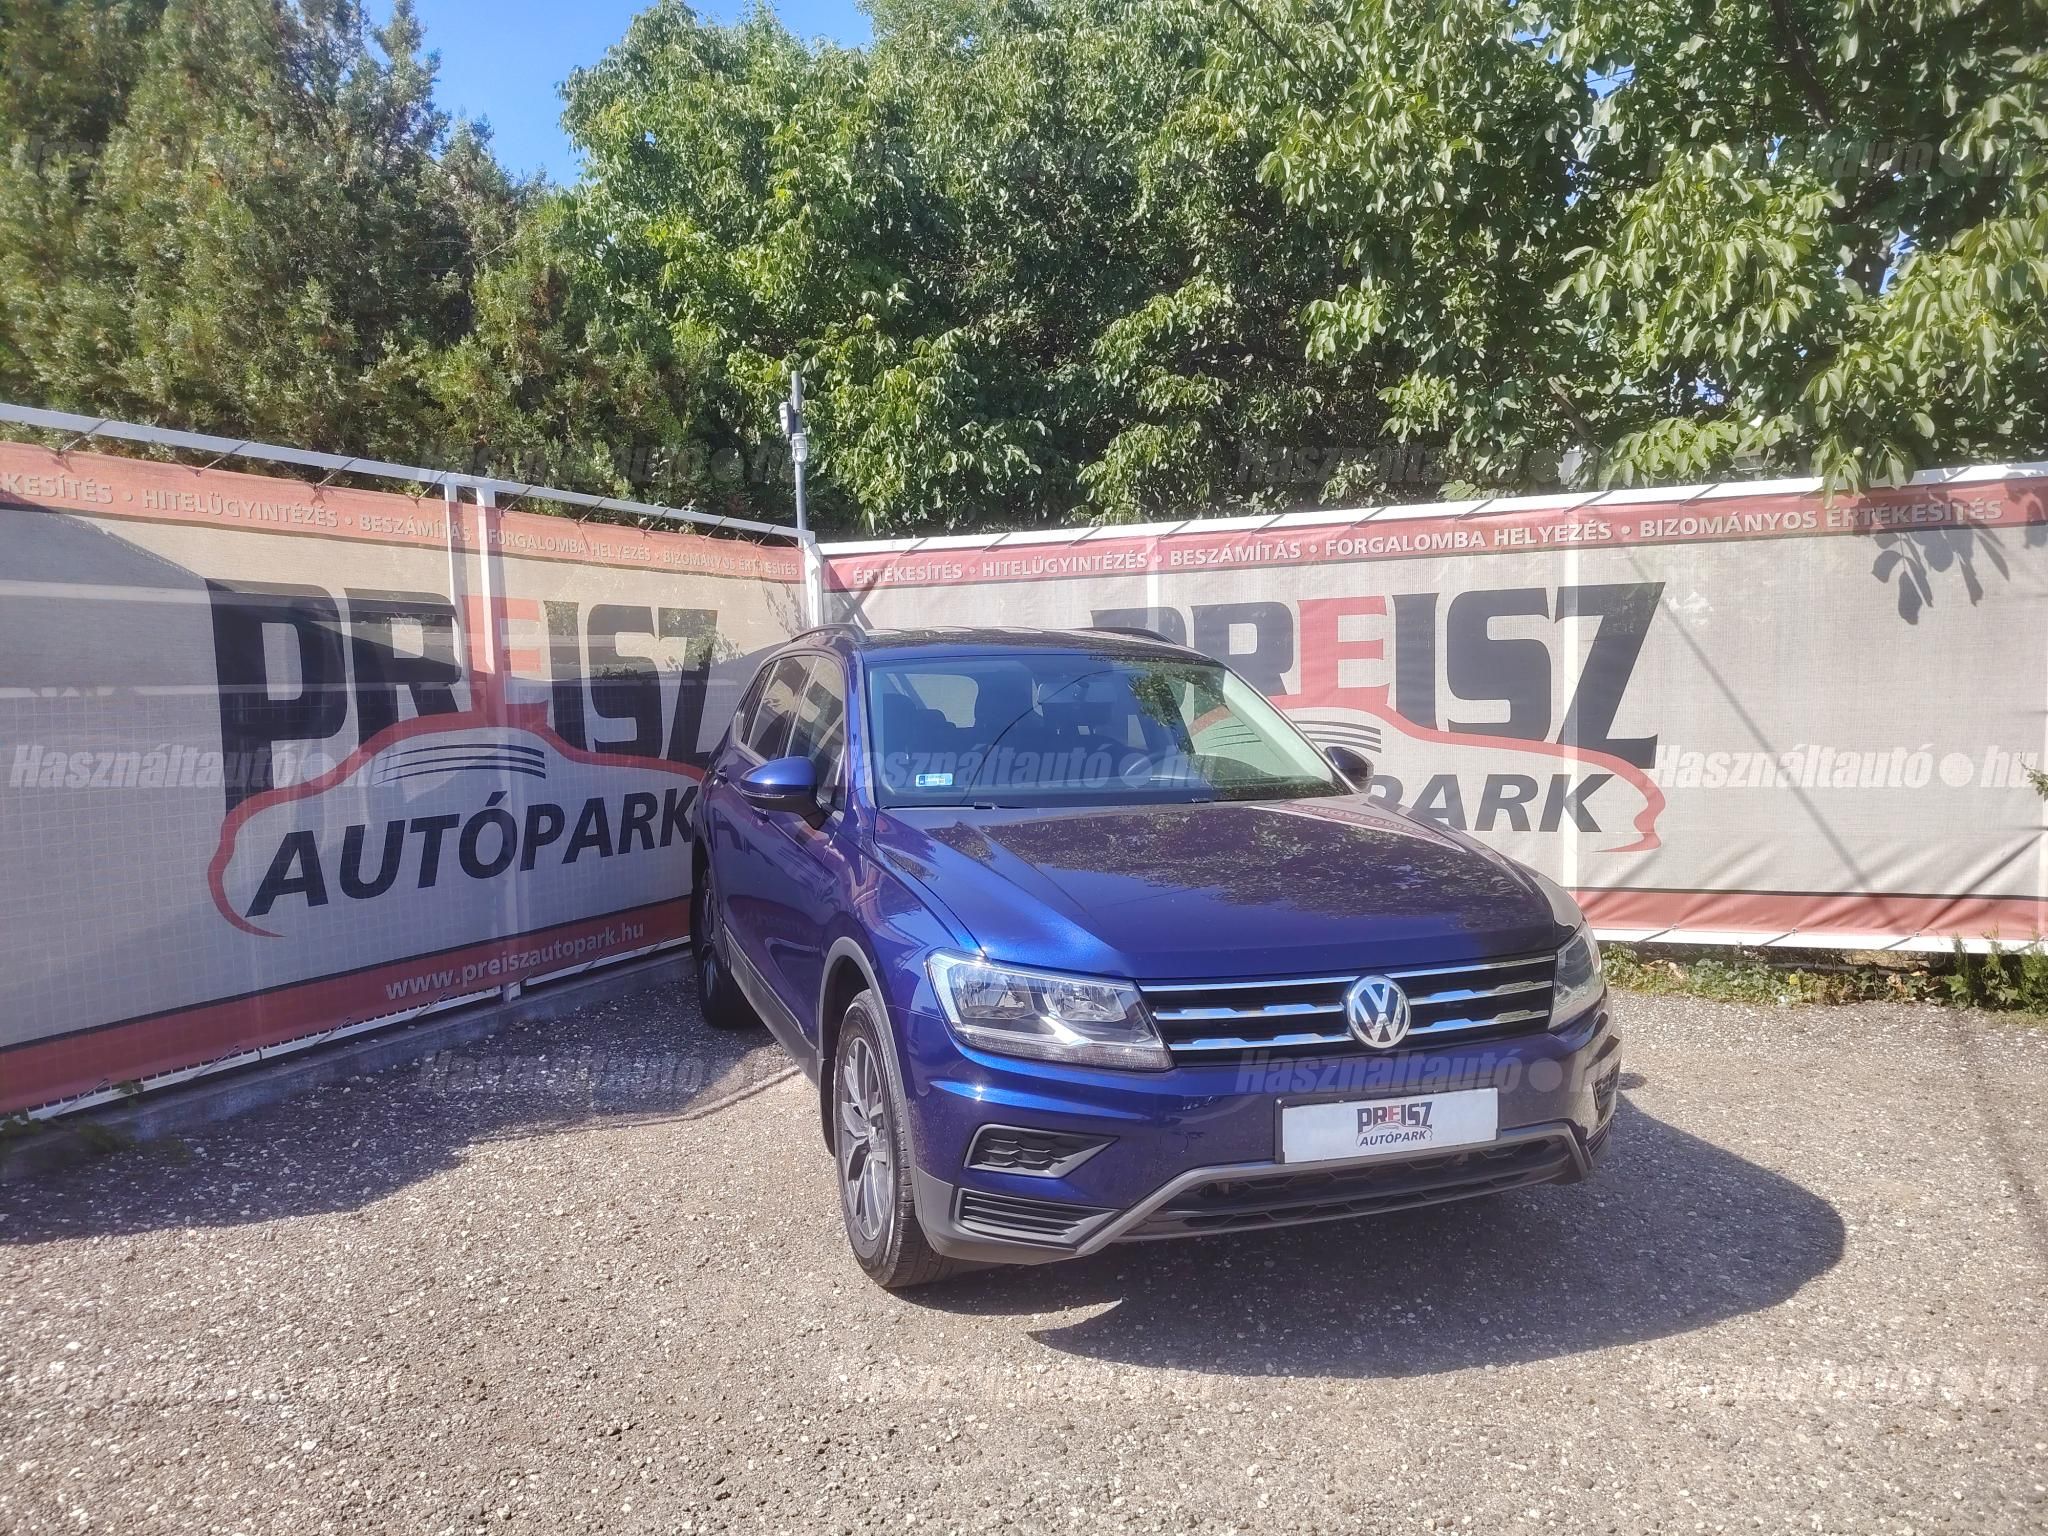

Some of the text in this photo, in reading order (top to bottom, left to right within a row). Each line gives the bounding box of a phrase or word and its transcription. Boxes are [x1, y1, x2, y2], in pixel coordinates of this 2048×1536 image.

[144, 489, 338, 528] HITELÜGYINTÉZÉS
[488, 528, 587, 554] FORGALOMBA
[592, 543, 651, 562] HELYEZÉS
[663, 550, 736, 570] BIZOMÁNYOS
[852, 498, 2003, 585] ÉRTÉKESÍTÉS HITELÜGYINTÉZÉS BESZÁMÍTÁS FORGALOMBA HELYEZÉS BIZOMÁNYOS ÉRTÉKESÍTÉS
[204, 577, 718, 812] PREISZ
[245, 785, 699, 918] AUTÓPARK
[384, 922, 645, 1000] www.preiszautopark.hu
[1357, 1102, 1433, 1134] PREISZ
[1359, 1130, 1428, 1147] AUTÓPARK
